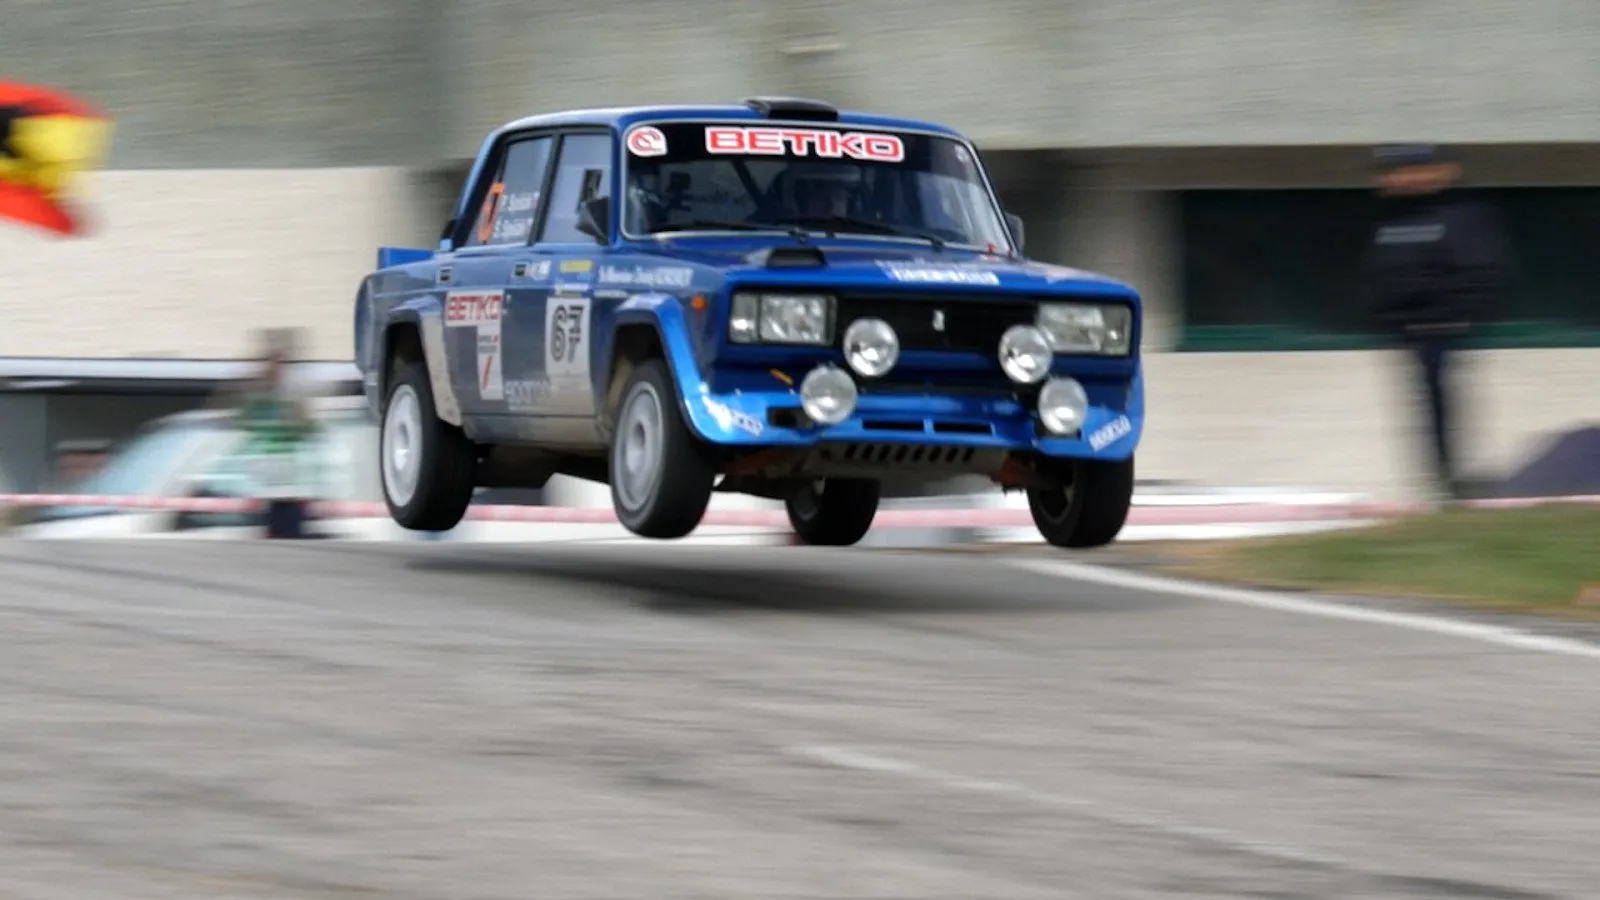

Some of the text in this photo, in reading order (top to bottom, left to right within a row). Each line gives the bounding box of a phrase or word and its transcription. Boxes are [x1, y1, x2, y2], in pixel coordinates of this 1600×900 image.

[706, 127, 904, 162] BETIKO
[447, 294, 504, 321] BETIKO
[551, 304, 585, 363] 67
